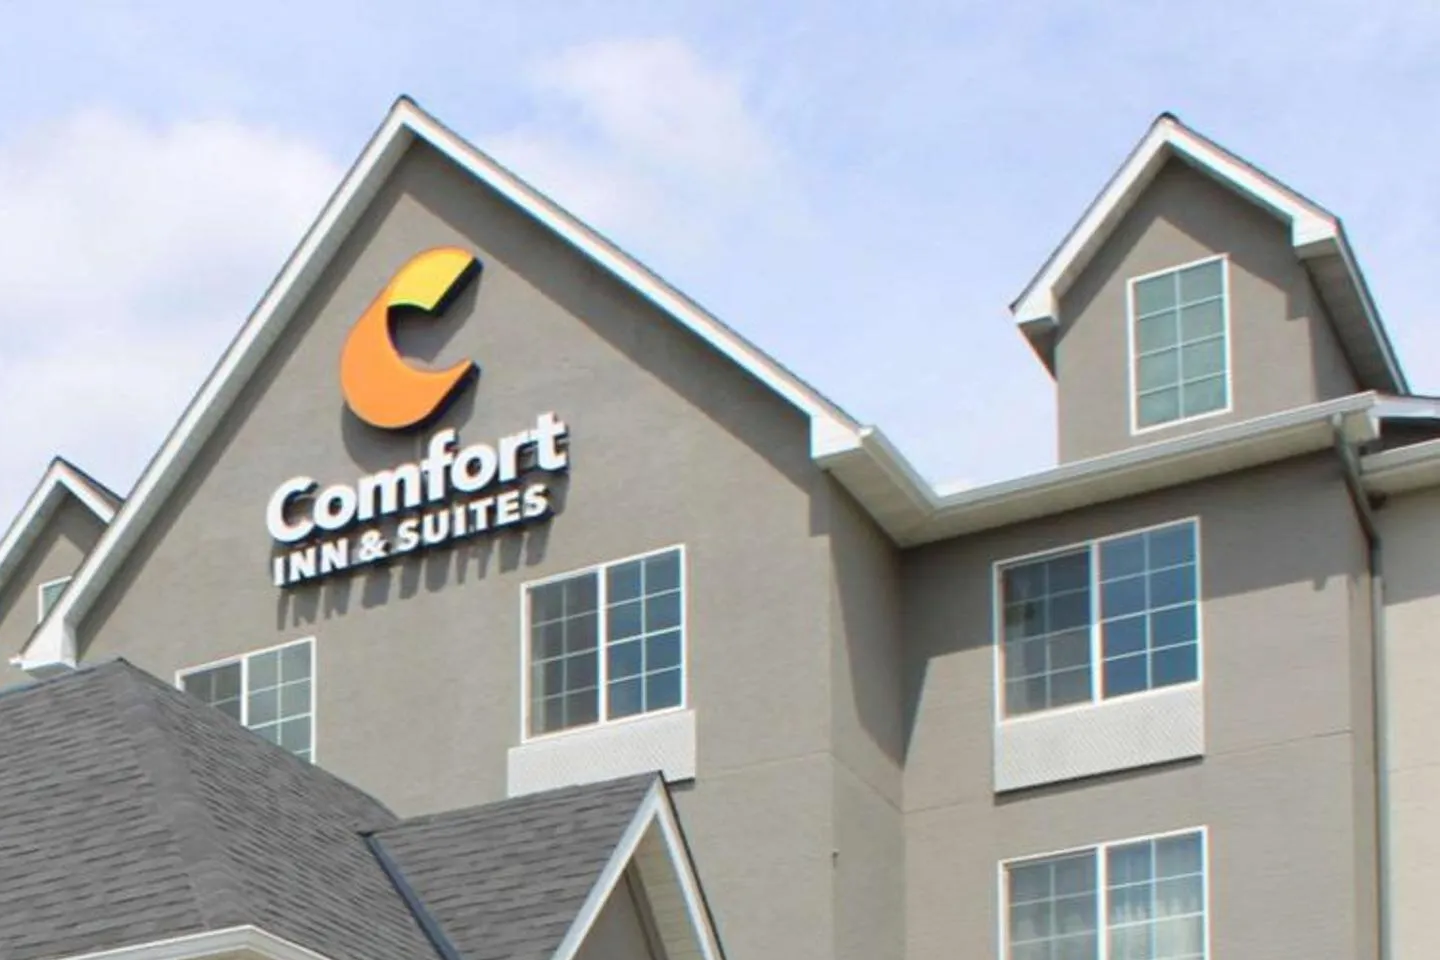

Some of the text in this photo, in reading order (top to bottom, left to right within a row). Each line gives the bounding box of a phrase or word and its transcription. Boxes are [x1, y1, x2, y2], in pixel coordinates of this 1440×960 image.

[266, 411, 568, 543] Comfort
[274, 484, 549, 587] INN & SUITES
